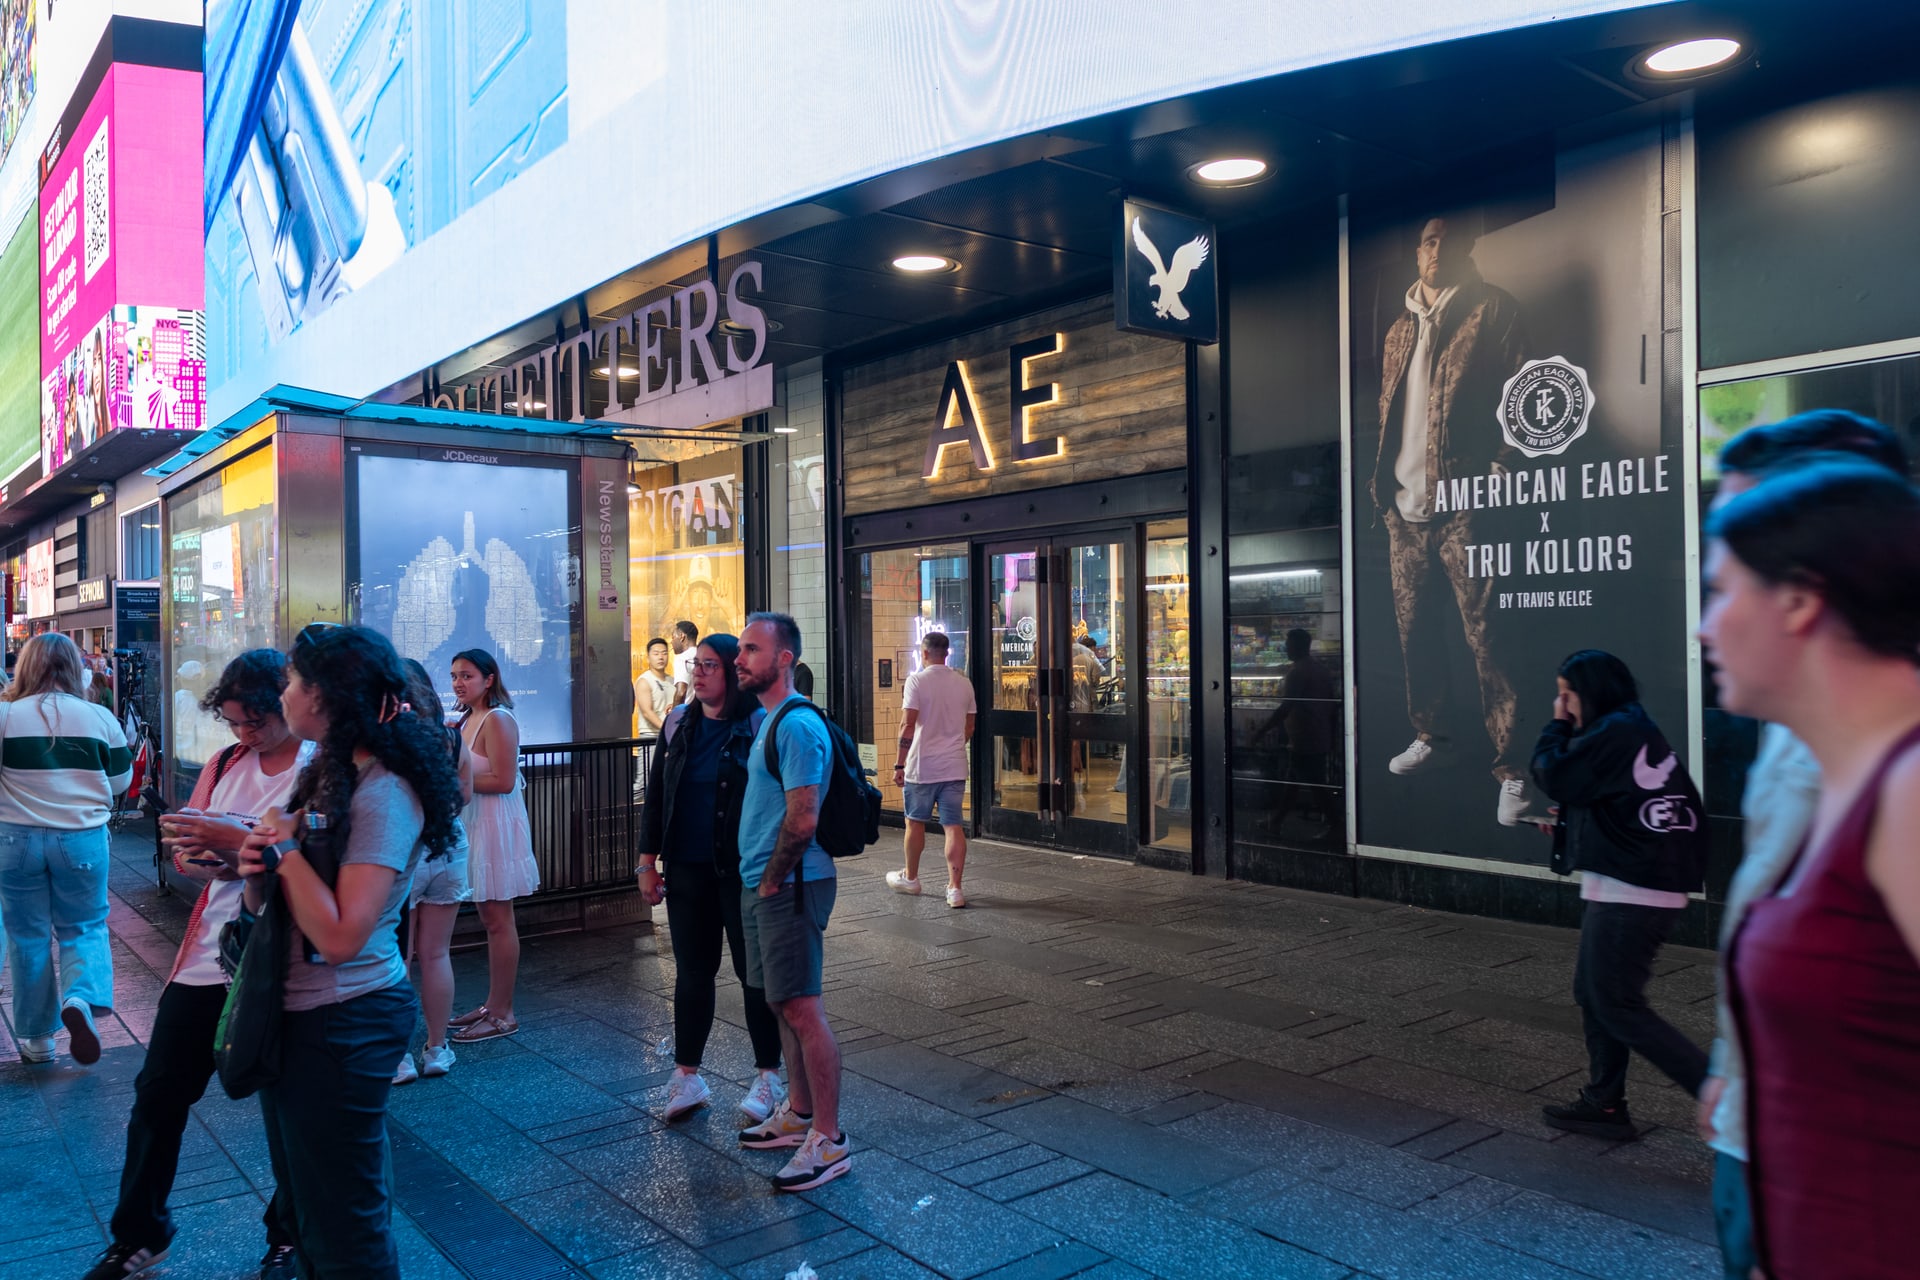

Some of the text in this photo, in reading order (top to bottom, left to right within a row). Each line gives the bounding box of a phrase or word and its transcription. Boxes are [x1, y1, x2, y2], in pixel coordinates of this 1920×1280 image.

[55, 187, 64, 228] ON
[64, 166, 79, 212] OUR
[45, 206, 77, 276] BILLBOARD
[155, 319, 179, 330] NYC
[920, 331, 1065, 479] AE
[1507, 367, 1583, 419] AMERICAN EAGLE 1977
[442, 450, 499, 464] JCDecaux
[1524, 431, 1567, 447] TRU KOLORS
[1434, 455, 1670, 513] AMERICAN EAGLE
[599, 480, 616, 590] Newsstand
[1464, 534, 1633, 578] TRU KOLORS
[79, 580, 105, 604] SEPHORA
[1499, 589, 1593, 609] BY TRAVIS KELCE
[1001, 643, 1033, 652] AMERICAN
